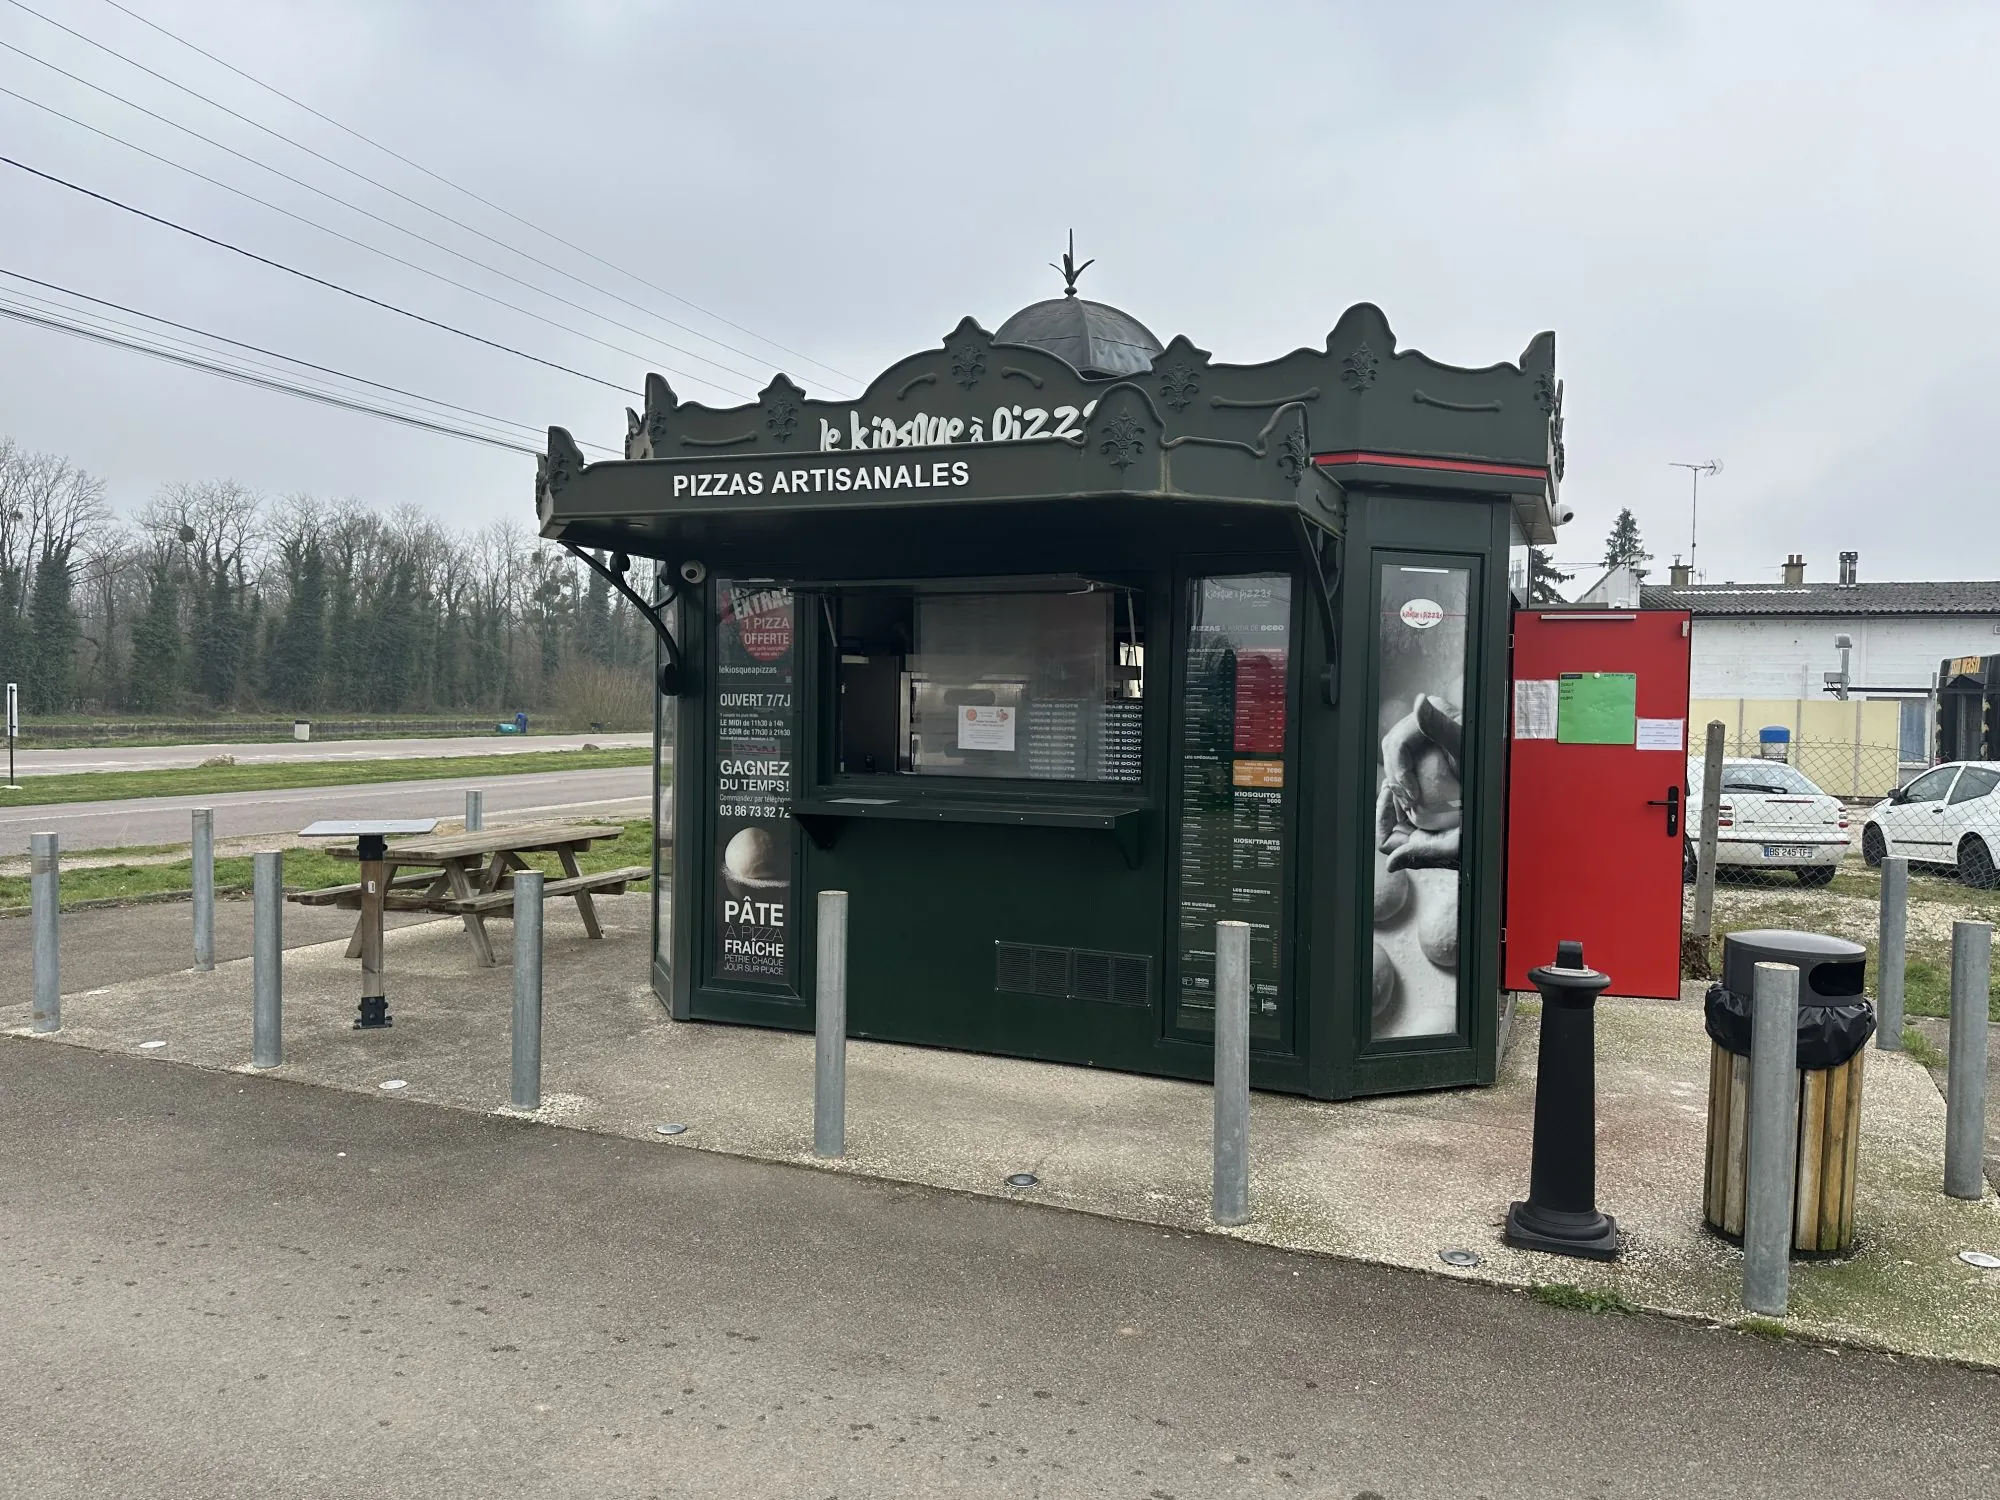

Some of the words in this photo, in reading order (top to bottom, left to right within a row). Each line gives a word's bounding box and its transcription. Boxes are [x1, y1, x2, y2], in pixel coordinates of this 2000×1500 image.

[820, 418, 842, 451] le
[673, 471, 764, 497] PIZZAS
[771, 461, 970, 494] ARTISANALES
[743, 618, 750, 630] 1
[753, 618, 790, 630] PIZZA
[744, 633, 790, 645] OFFERTE
[720, 693, 764, 707] OUVERT
[766, 693, 791, 707] 7/7J
[720, 760, 790, 776] GAGNEZ
[720, 779, 738, 790] DU
[720, 804, 732, 816] 03
[734, 805, 747, 816] 86
[749, 806, 761, 817] 73
[763, 806, 776, 818] 32
[724, 896, 784, 927] PÂTE
[741, 925, 784, 942] PIZZA
[724, 938, 784, 957] FRAÎCHE
[751, 956, 784, 967] CHAQUE
[724, 962, 744, 972] JOUR
[744, 964, 760, 973] SUR
[760, 965, 784, 976] PLACE
